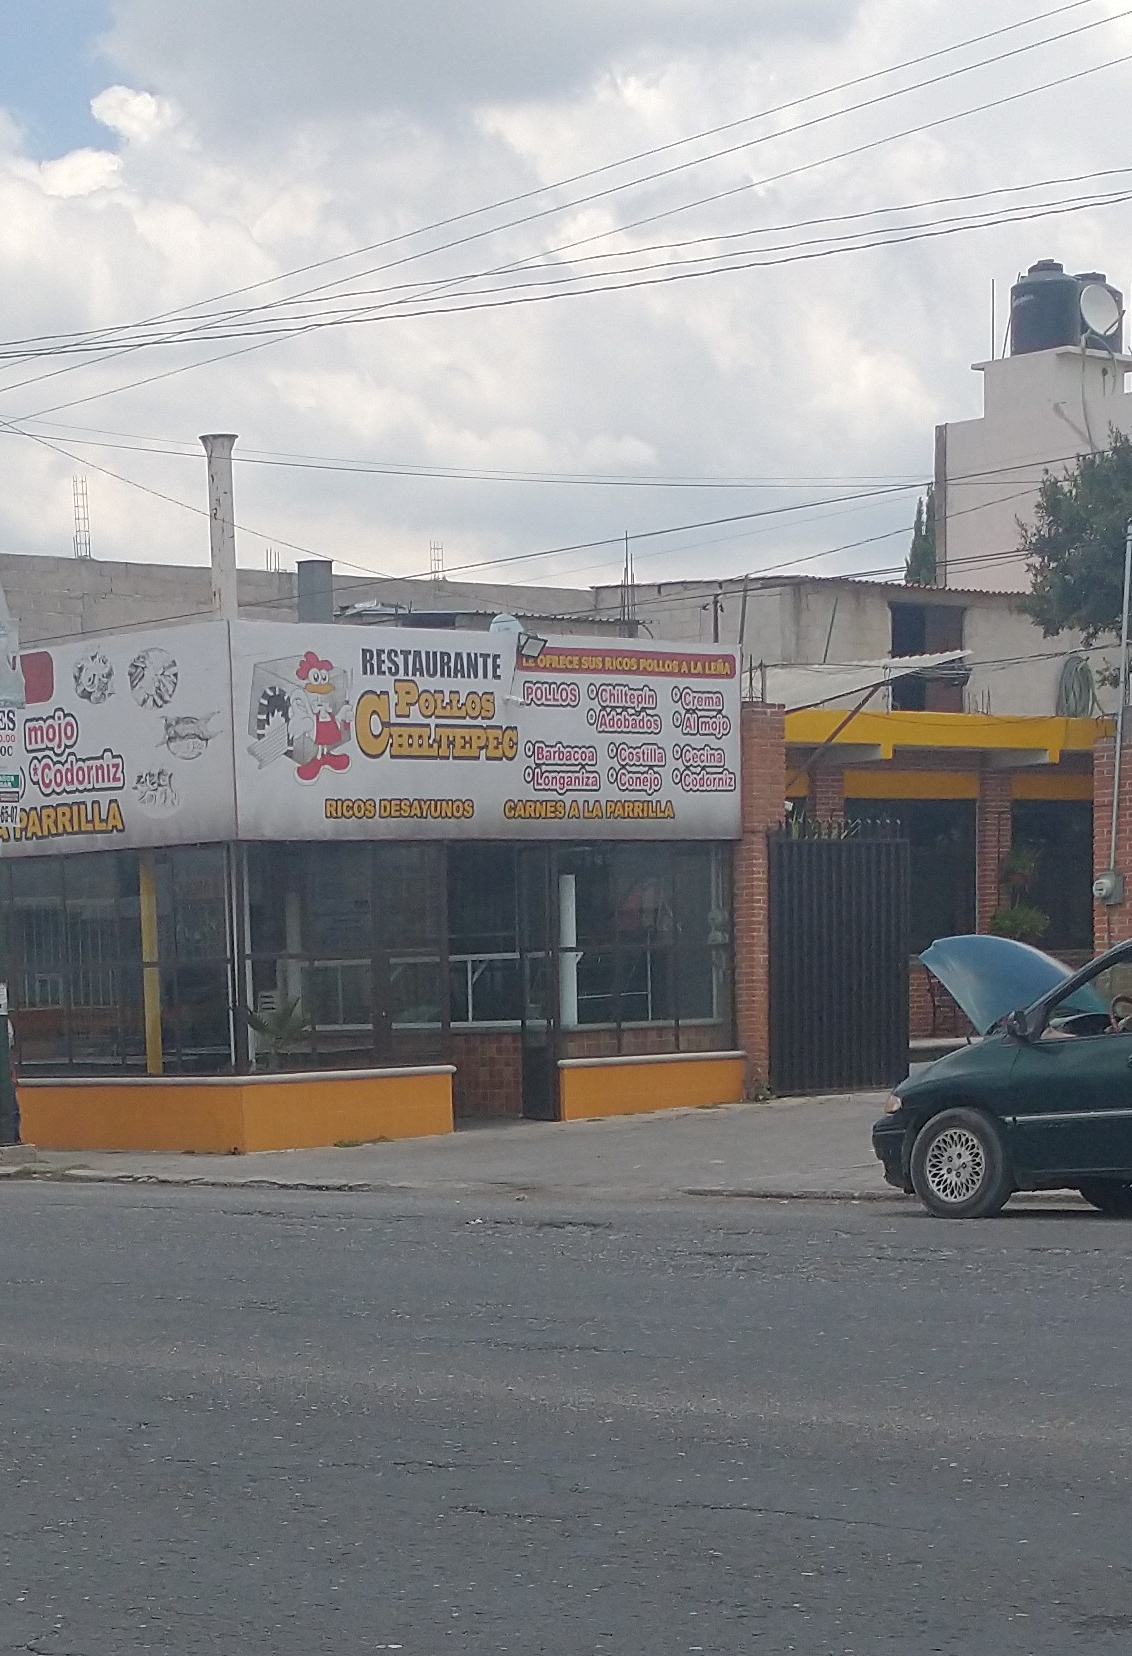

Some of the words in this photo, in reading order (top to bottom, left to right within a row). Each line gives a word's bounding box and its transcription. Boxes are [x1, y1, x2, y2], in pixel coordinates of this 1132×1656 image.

[361, 648, 501, 680] RESTAURANTE
[538, 655, 579, 669] OFRECE
[581, 655, 602, 669] SUS
[605, 656, 637, 671] RICOS
[639, 659, 679, 673] POLLOS
[680, 660, 689, 673] A
[691, 661, 703, 674] LA
[705, 659, 731, 675] LEÑA
[394, 679, 495, 720] POLLOS
[524, 684, 578, 704] POLLOS
[683, 691, 722, 707] Crema
[27, 715, 75, 748] mojo
[355, 690, 518, 760] CHILTEPEC
[598, 713, 660, 730] Adobados
[684, 716, 696, 733] Al
[699, 715, 729, 736] mojo
[535, 745, 595, 763] Barbacoa
[619, 746, 665, 764] Costilla
[683, 746, 723, 764] Cecina
[41, 759, 122, 789] Codorniz
[535, 772, 599, 792] Longaniza
[619, 773, 660, 792] Conejo
[683, 772, 734, 789] Codorniz
[14, 799, 125, 841] PARRILLA
[325, 798, 376, 819] RICOS
[379, 798, 474, 819] DESAYUNOS
[504, 799, 566, 819] CARNES
[568, 799, 580, 819] A
[582, 799, 603, 819] LA
[606, 799, 675, 819] PARRILLA
